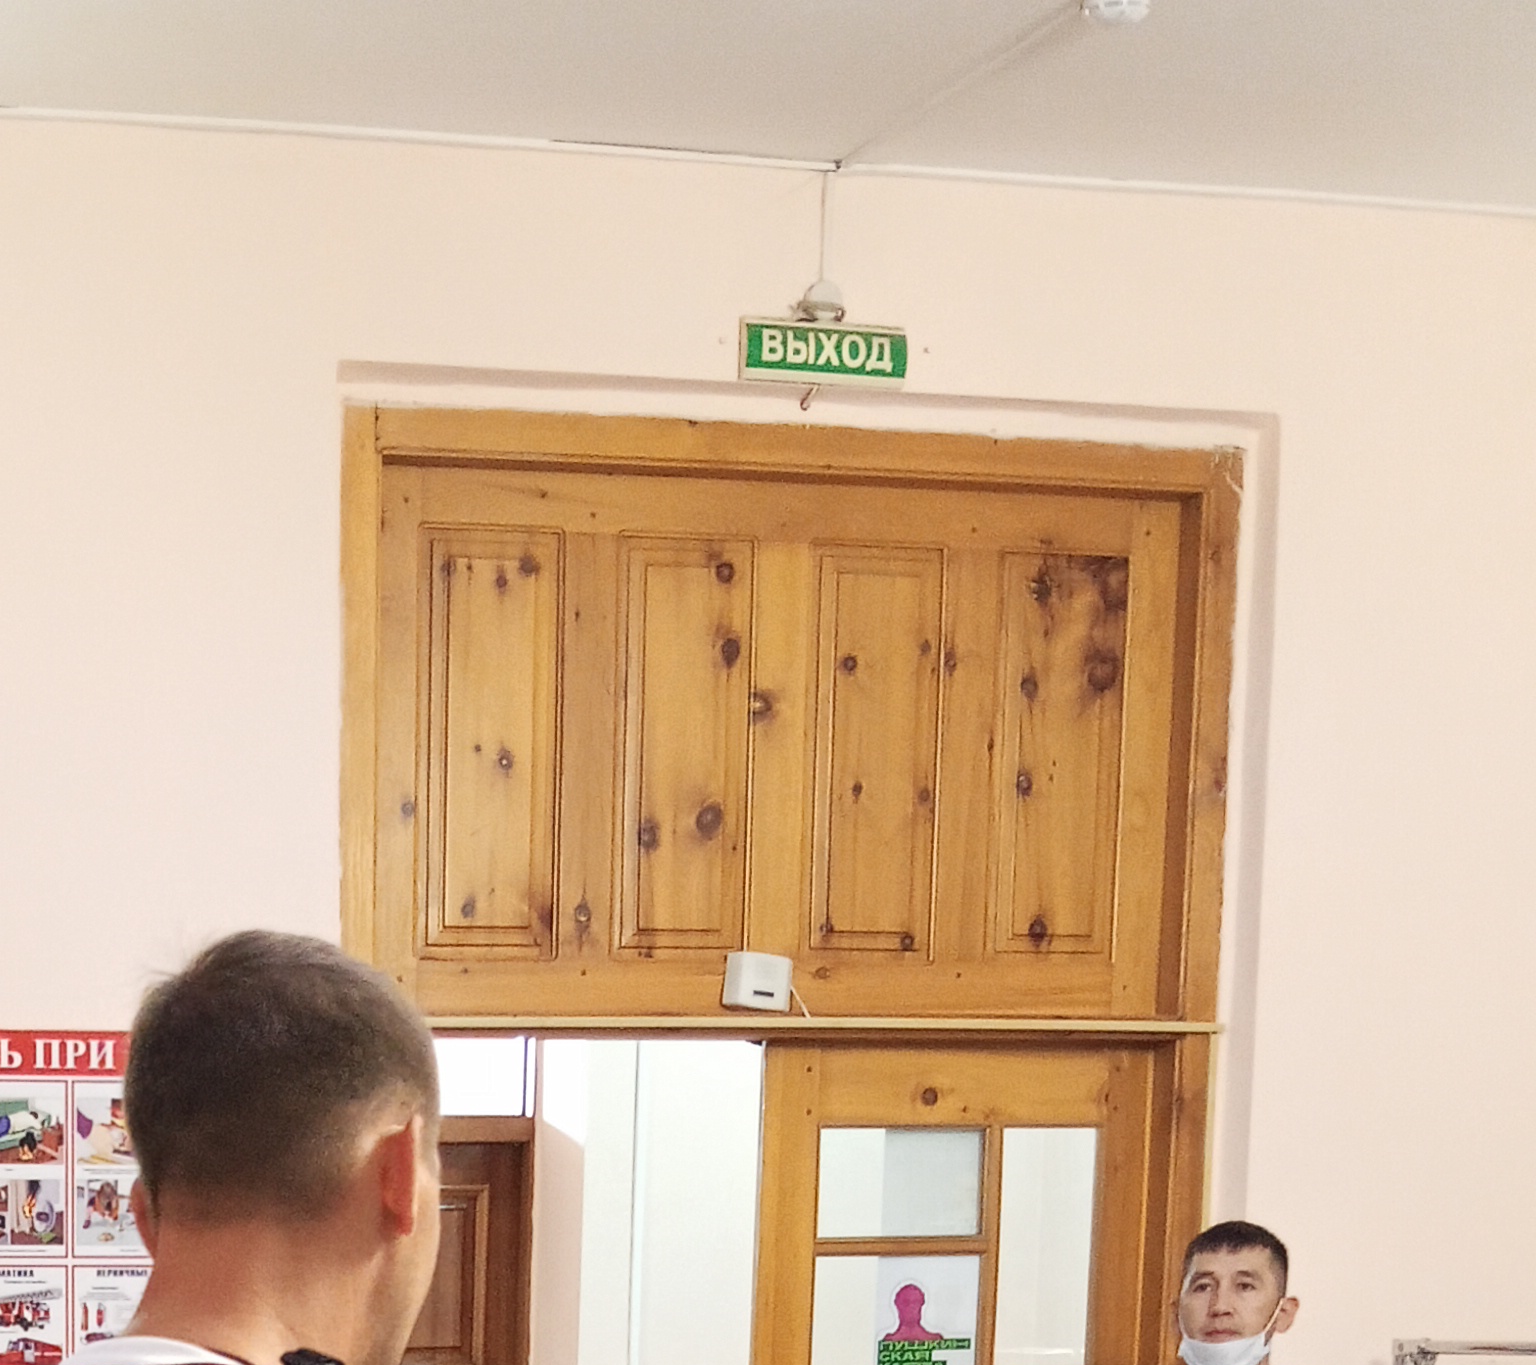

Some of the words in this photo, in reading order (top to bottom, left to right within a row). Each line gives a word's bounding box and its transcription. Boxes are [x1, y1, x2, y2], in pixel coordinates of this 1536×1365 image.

[760, 327, 894, 374] ВЫХОД
[33, 1037, 116, 1070] ПРИ
[878, 1339, 971, 1351] ПУШКИН
[878, 1351, 931, 1362] СКАЯ
